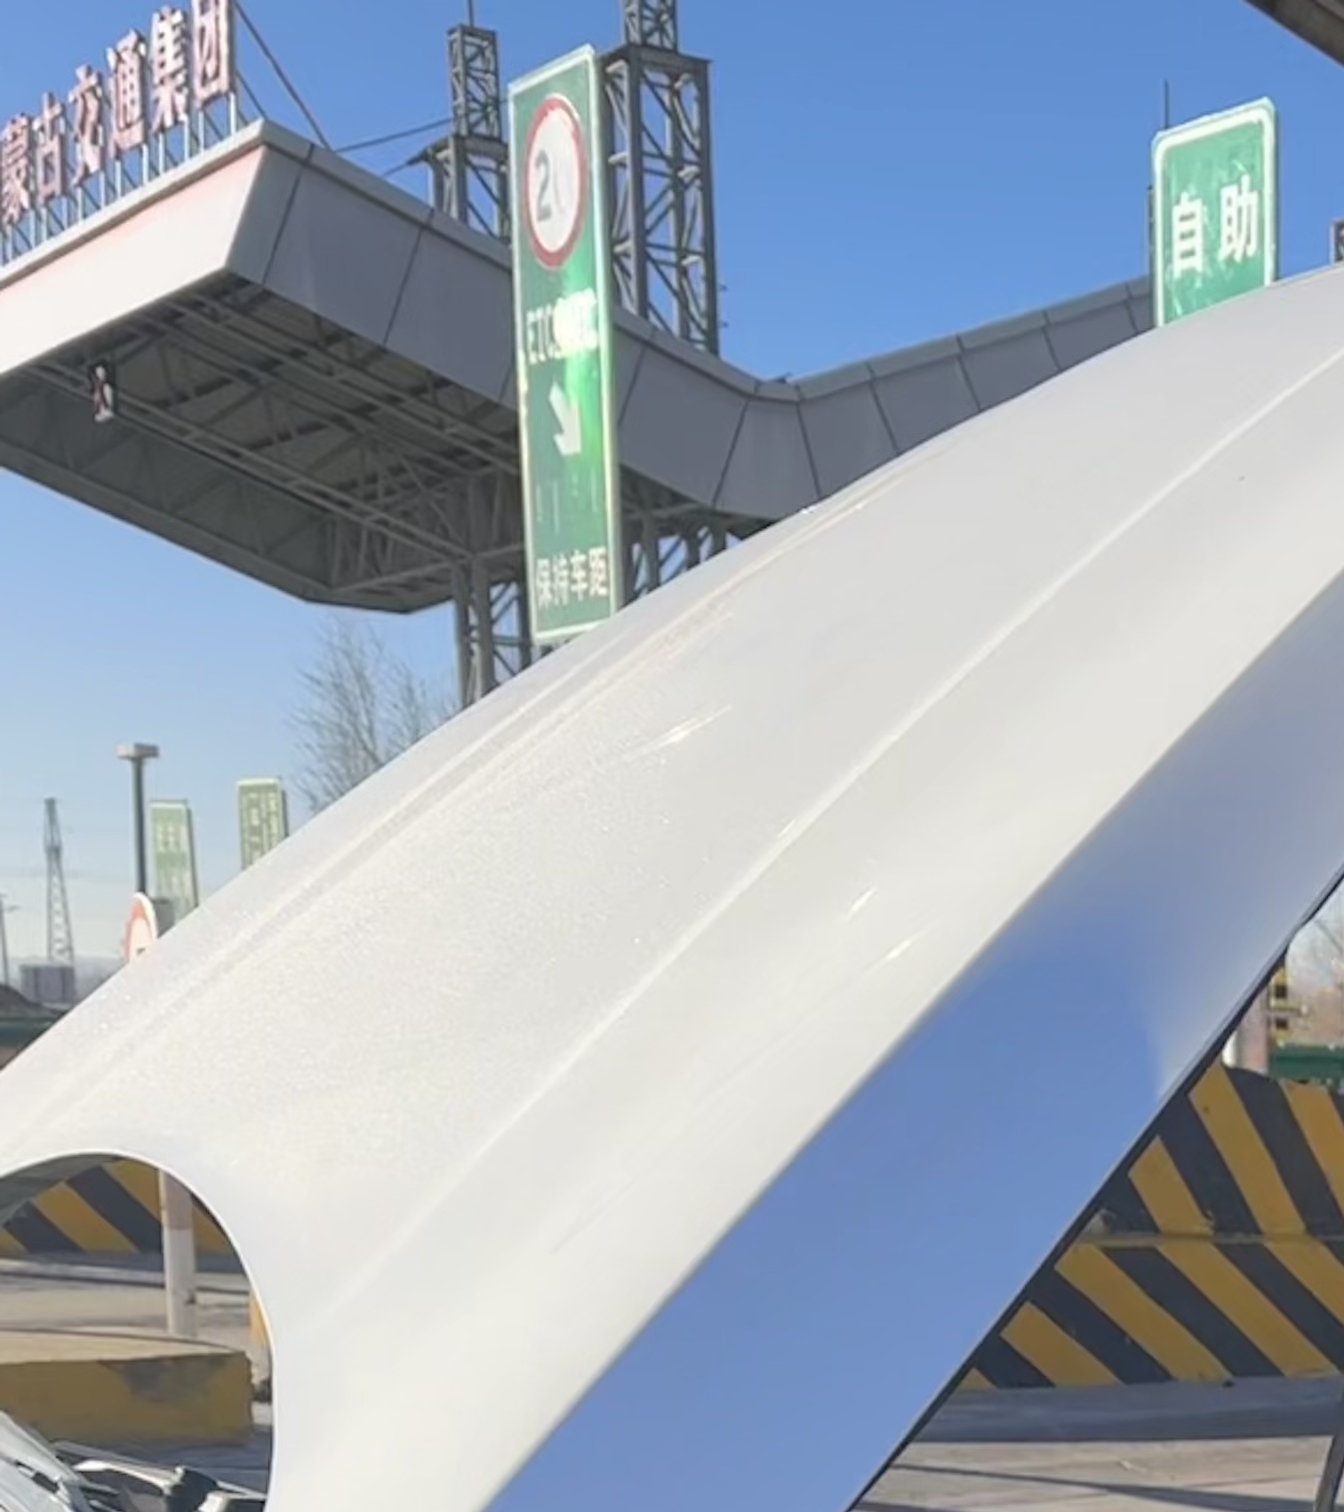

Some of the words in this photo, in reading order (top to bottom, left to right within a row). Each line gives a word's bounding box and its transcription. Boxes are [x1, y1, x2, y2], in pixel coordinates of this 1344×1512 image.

[0, 0, 231, 227] 蒙古交通集团
[1170, 172, 1259, 280] 自助
[535, 546, 608, 609] 保持车距
